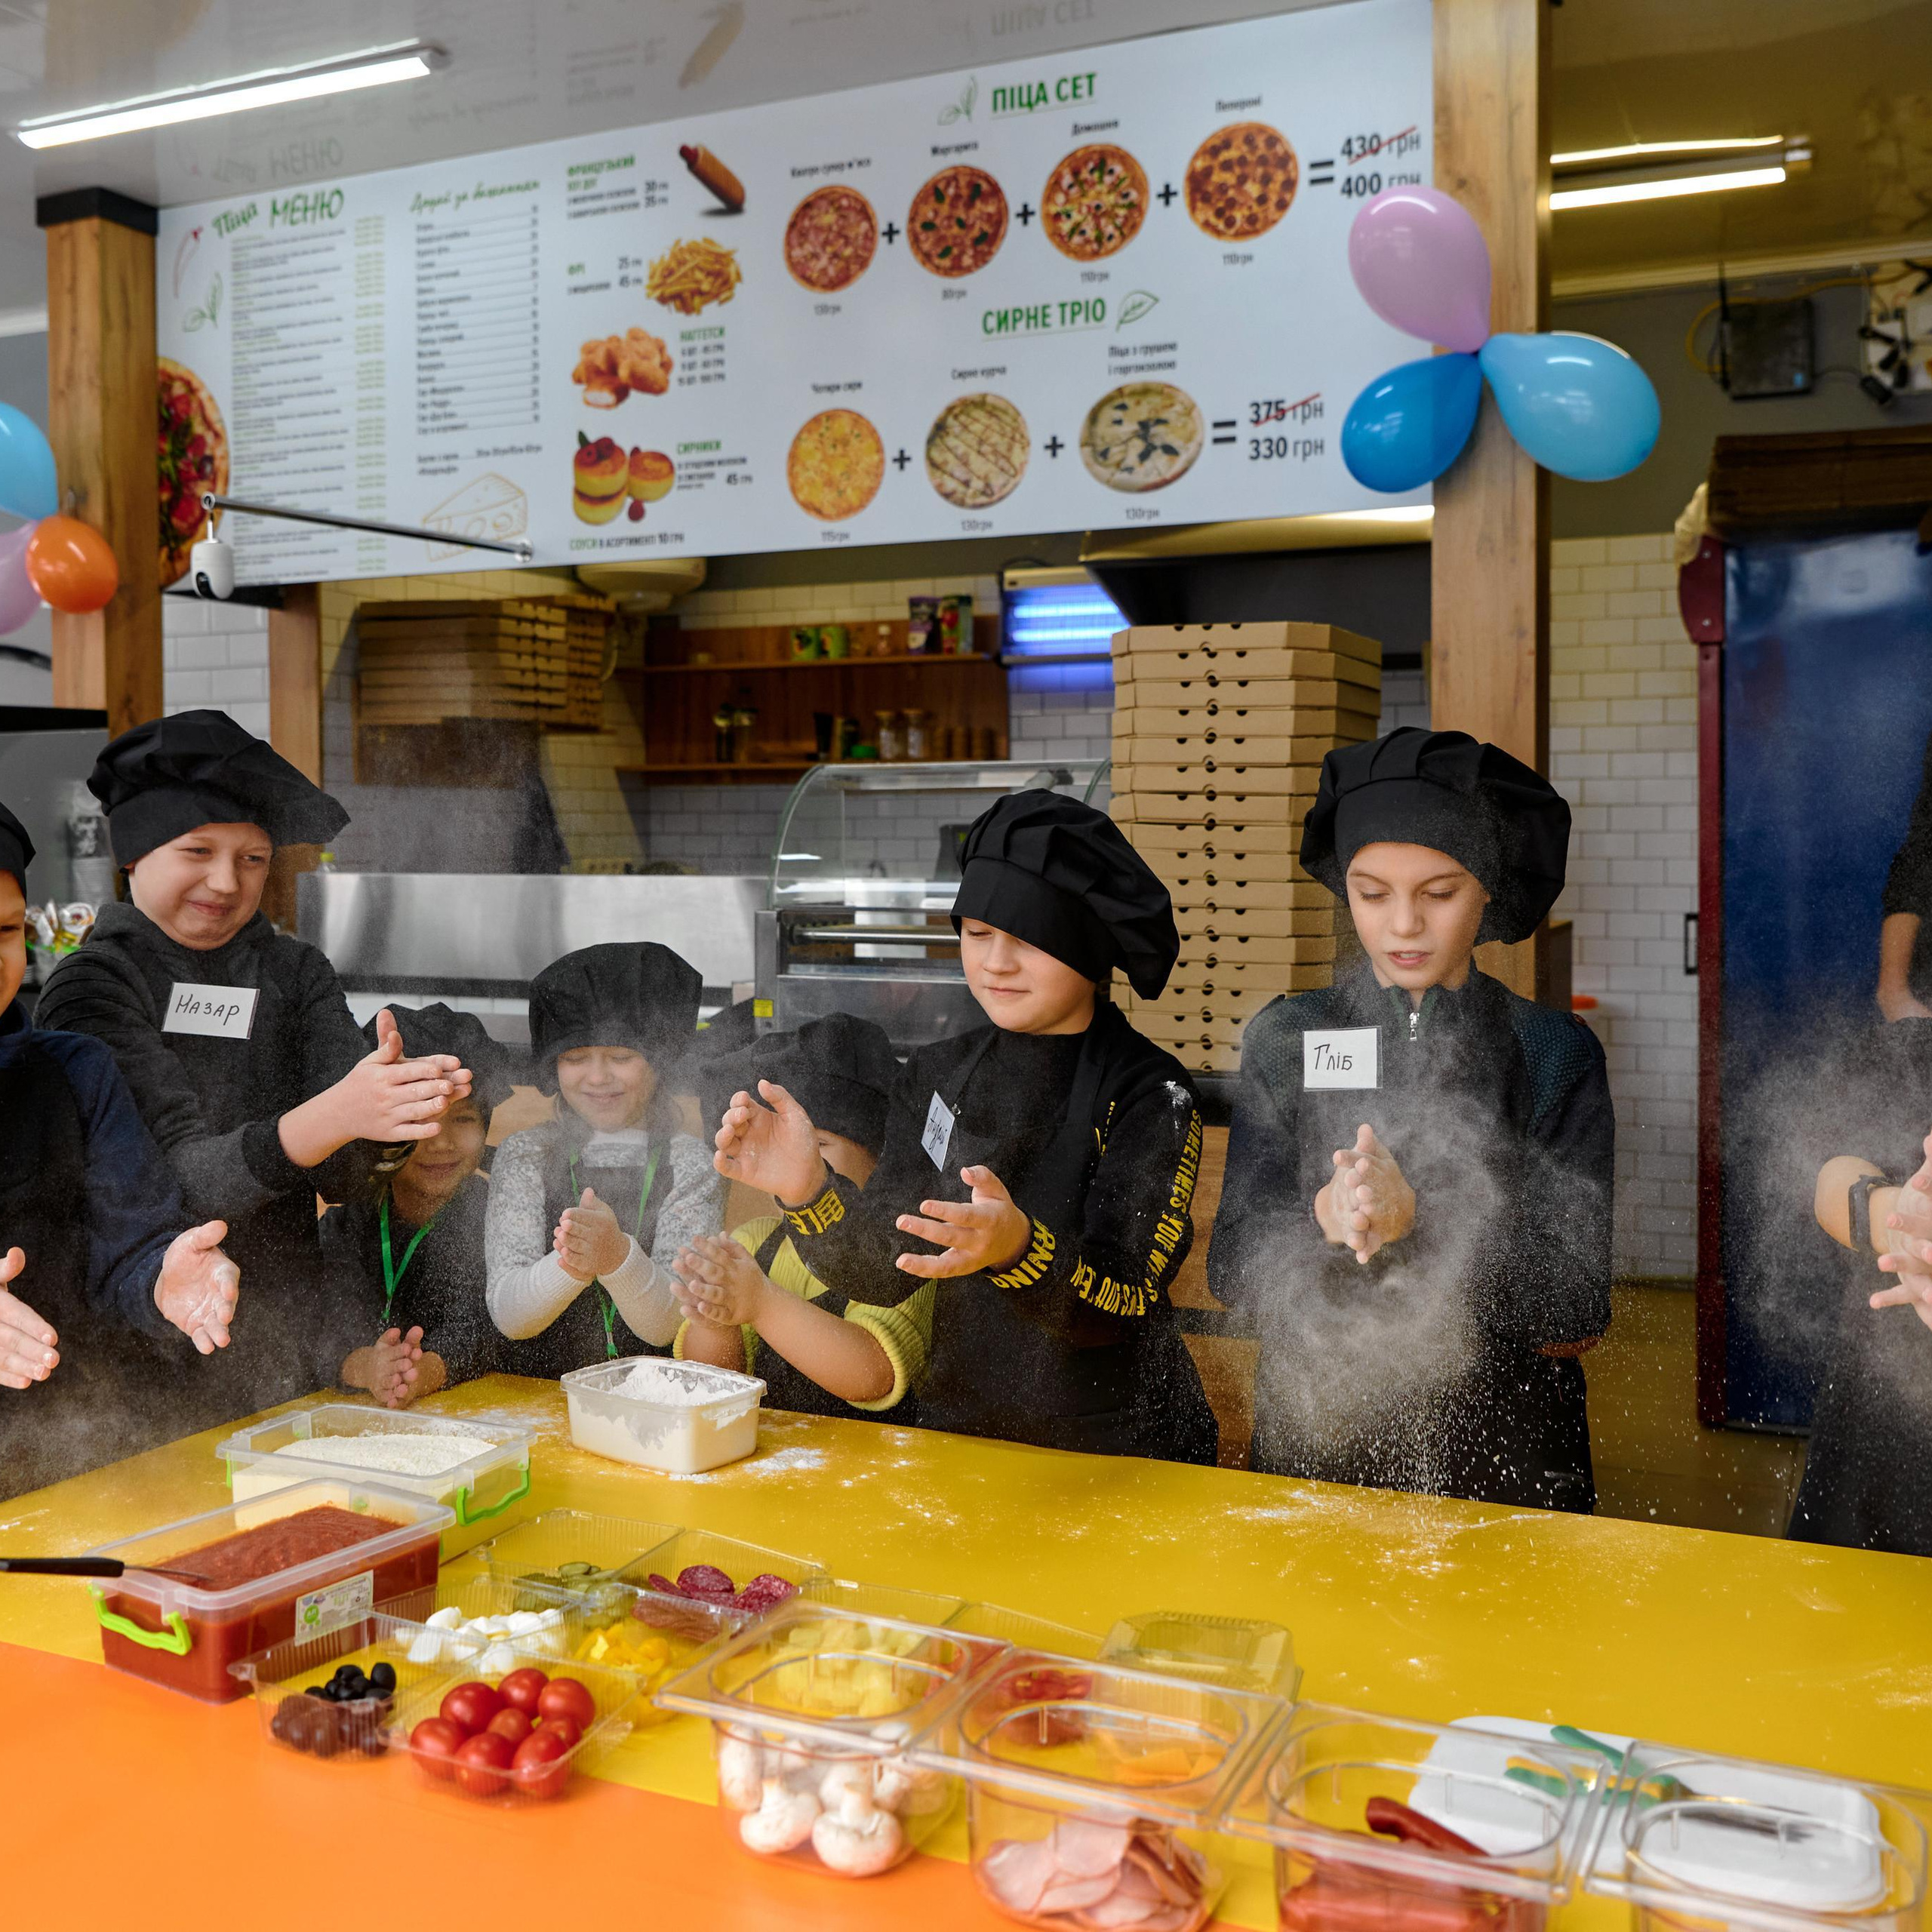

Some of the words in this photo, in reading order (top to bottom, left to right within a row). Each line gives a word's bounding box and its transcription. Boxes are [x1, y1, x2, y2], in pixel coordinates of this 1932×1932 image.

[992, 82, 1048, 113] ПІЦА
[1056, 72, 1097, 101] СЕТ
[1340, 133, 1383, 159] 430
[1387, 132, 1422, 158] грн
[1340, 173, 1383, 198] 400
[269, 187, 345, 228] МЕНЮ
[983, 303, 1051, 335] СИРНЕ
[1058, 297, 1106, 327] ТРІО
[1108, 345, 1129, 358] Піца
[1249, 399, 1286, 425] 375
[1291, 399, 1324, 425] грн
[1249, 436, 1287, 461] 330
[1293, 438, 1325, 462] грн
[1169, 1109, 1202, 1214] SOMETIMES
[1154, 1212, 1185, 1256] YOU
